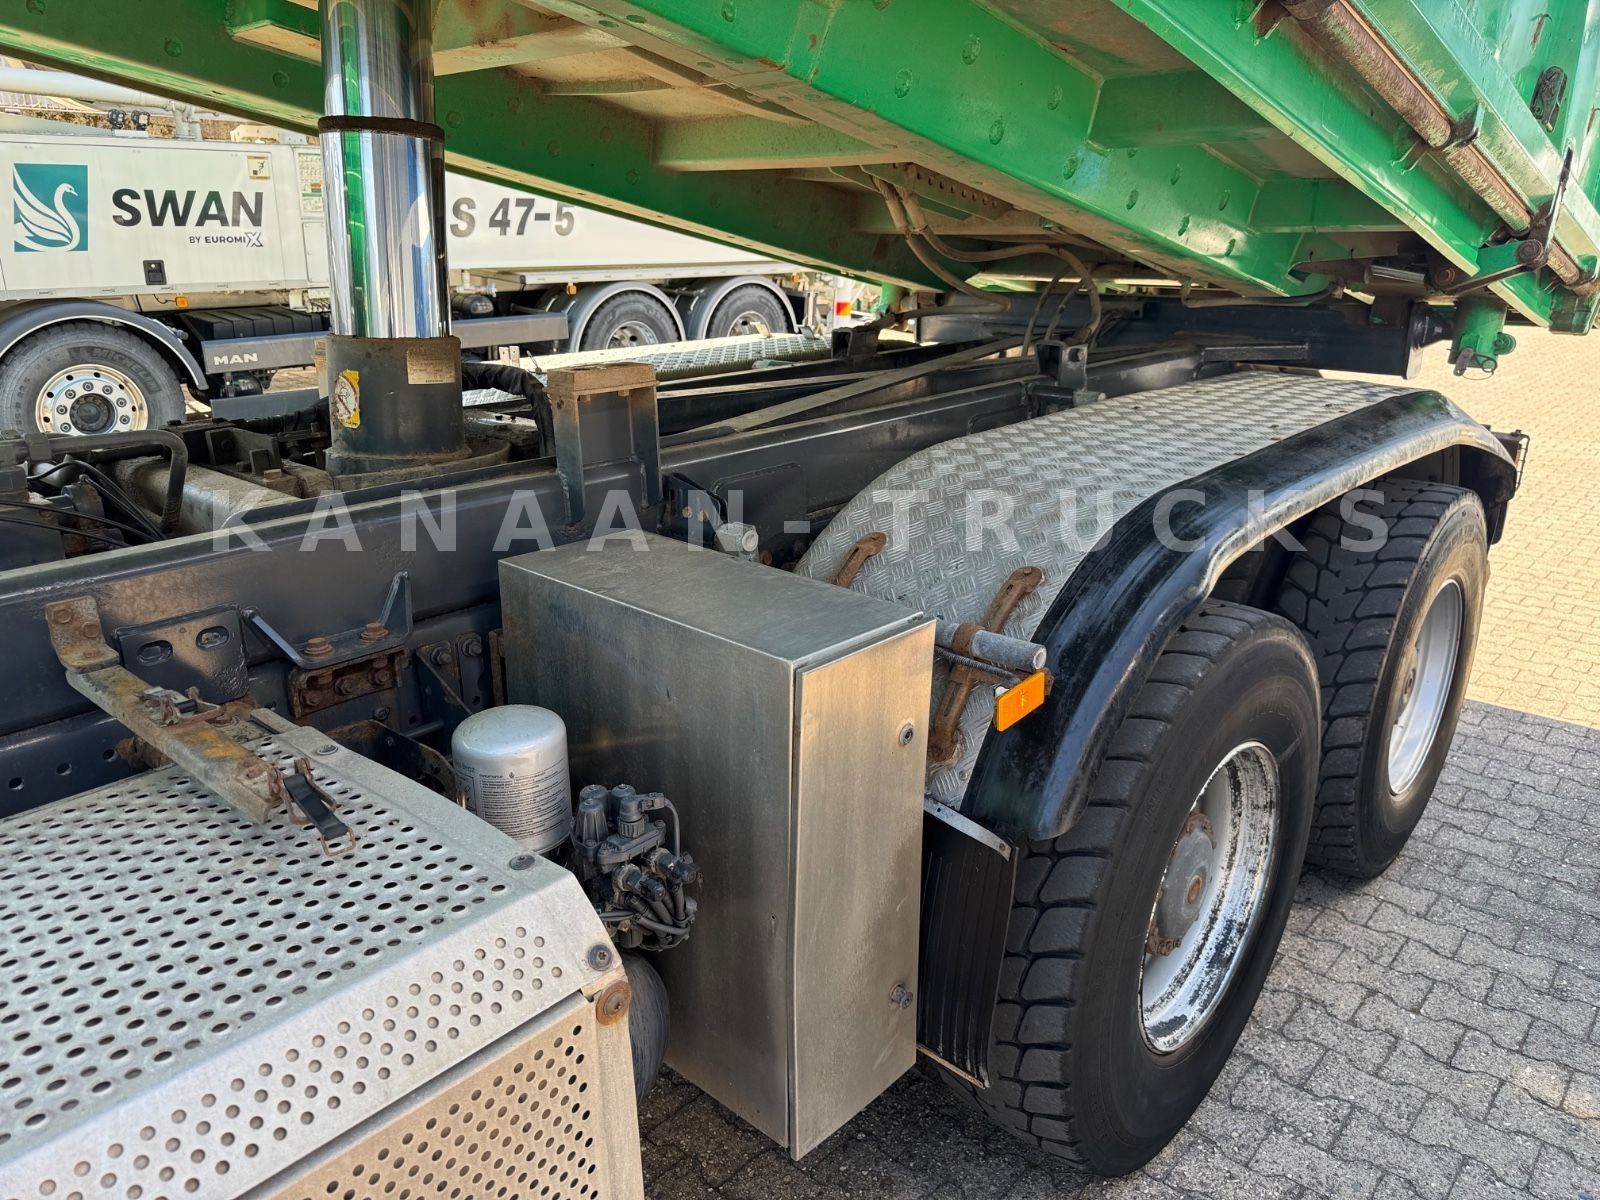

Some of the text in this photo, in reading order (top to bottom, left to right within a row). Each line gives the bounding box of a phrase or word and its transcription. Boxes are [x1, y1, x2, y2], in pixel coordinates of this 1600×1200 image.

[112, 188, 264, 227] SWAN
[450, 197, 576, 238] S 47-5
[189, 231, 264, 247] BY EUROMIX
[213, 352, 259, 366] MAN
